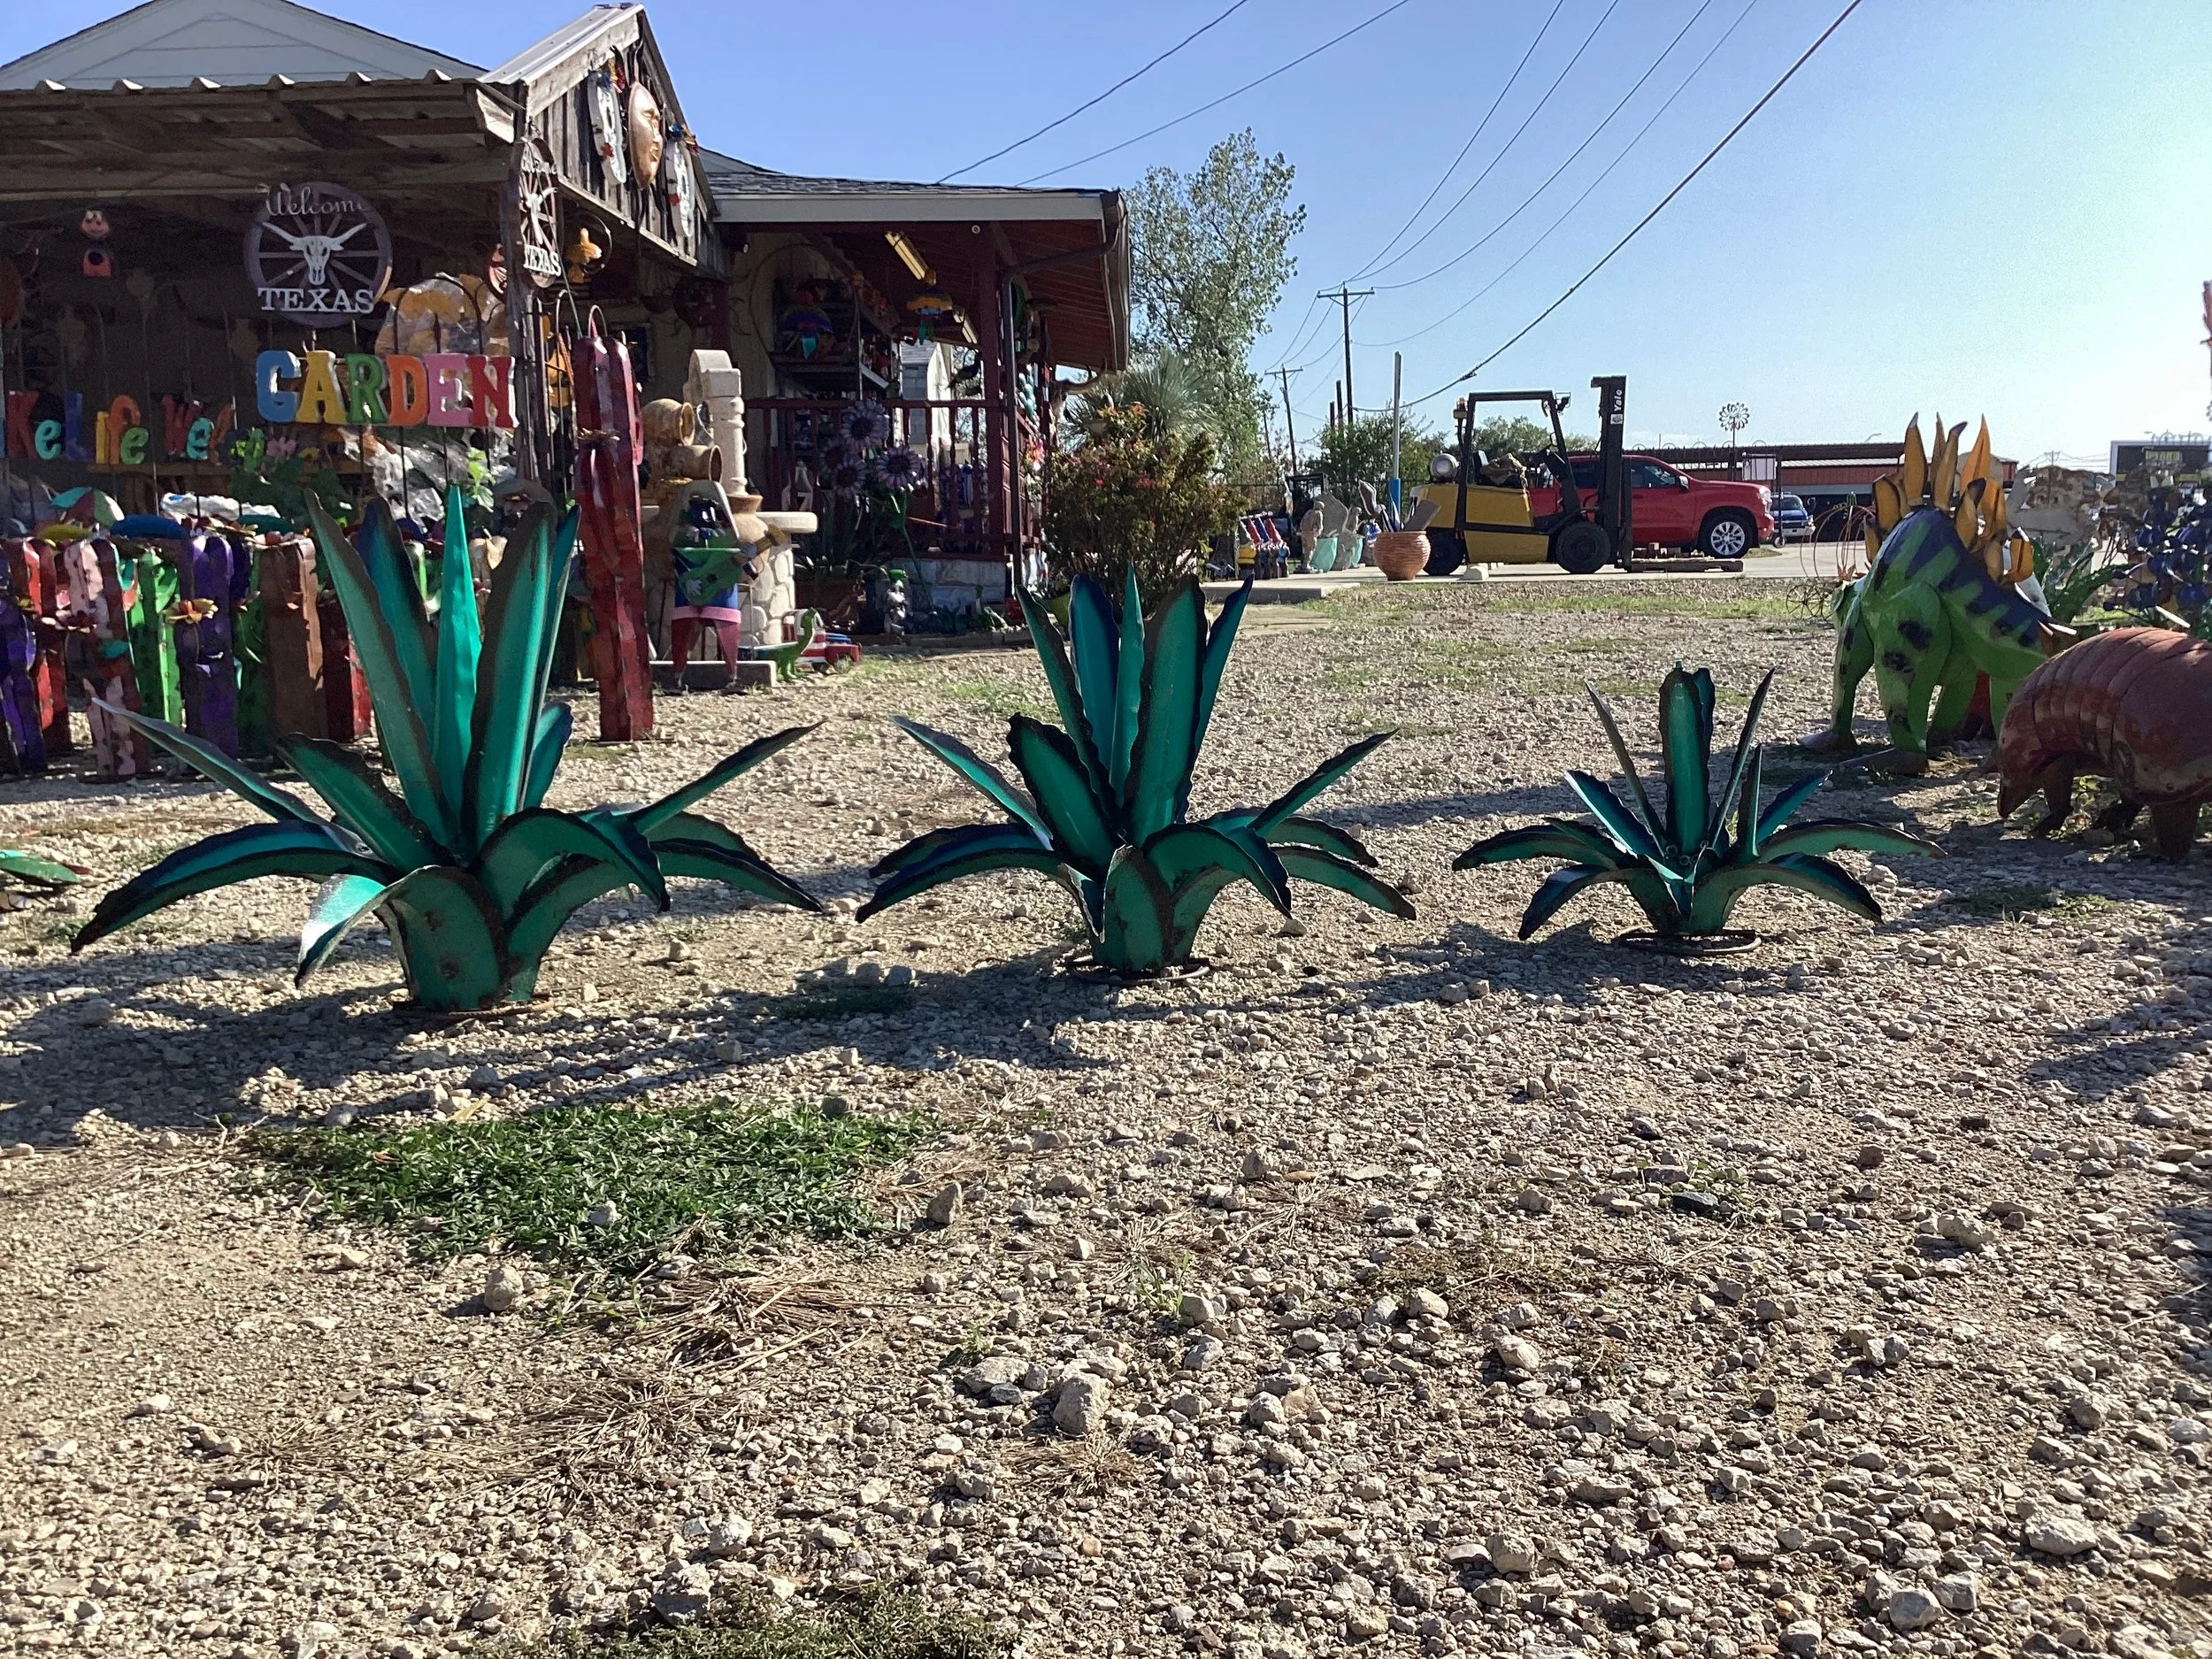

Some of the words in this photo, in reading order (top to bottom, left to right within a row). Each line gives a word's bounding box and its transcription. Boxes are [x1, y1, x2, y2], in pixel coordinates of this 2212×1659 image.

[524, 244, 562, 277] TEXAS
[257, 287, 375, 315] TEXAS
[256, 349, 520, 428] GARDEN
[1614, 389, 1623, 412] Yale
